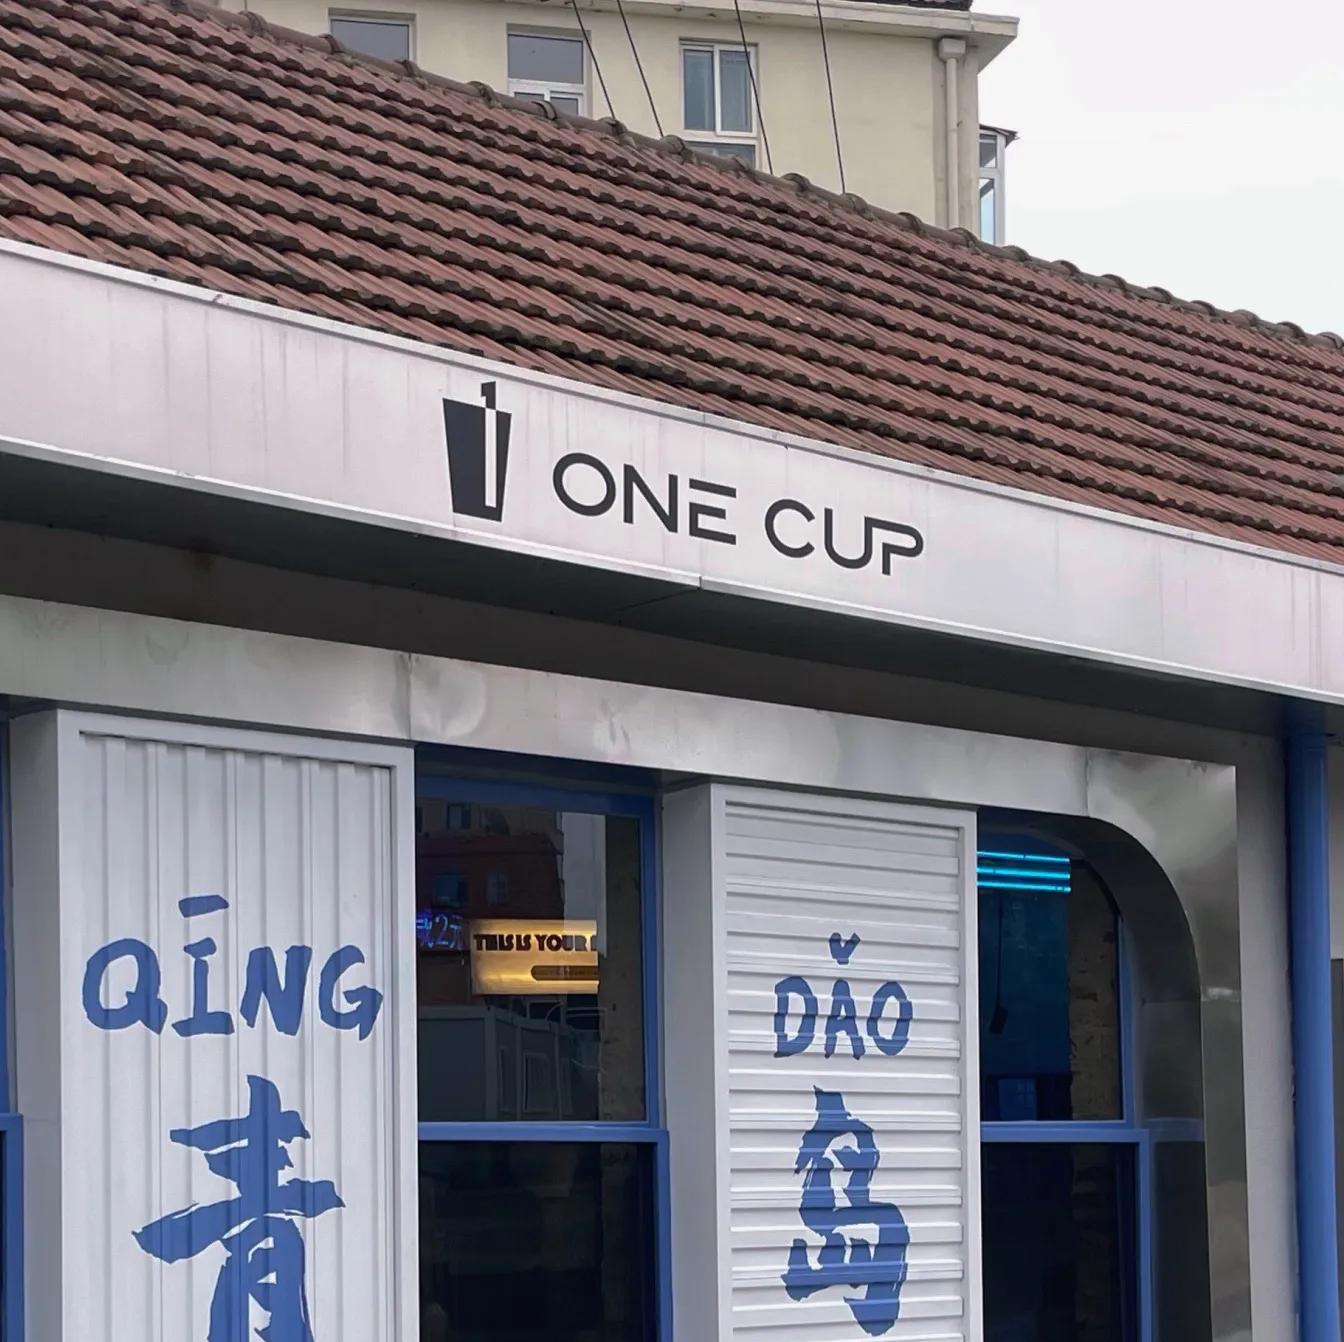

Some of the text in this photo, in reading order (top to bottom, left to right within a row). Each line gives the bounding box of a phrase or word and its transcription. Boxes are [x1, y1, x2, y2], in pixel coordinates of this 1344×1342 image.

[553, 452, 925, 576] ONE CUP
[534, 933, 588, 951] YOUR
[780, 1085, 912, 1337] 岛
